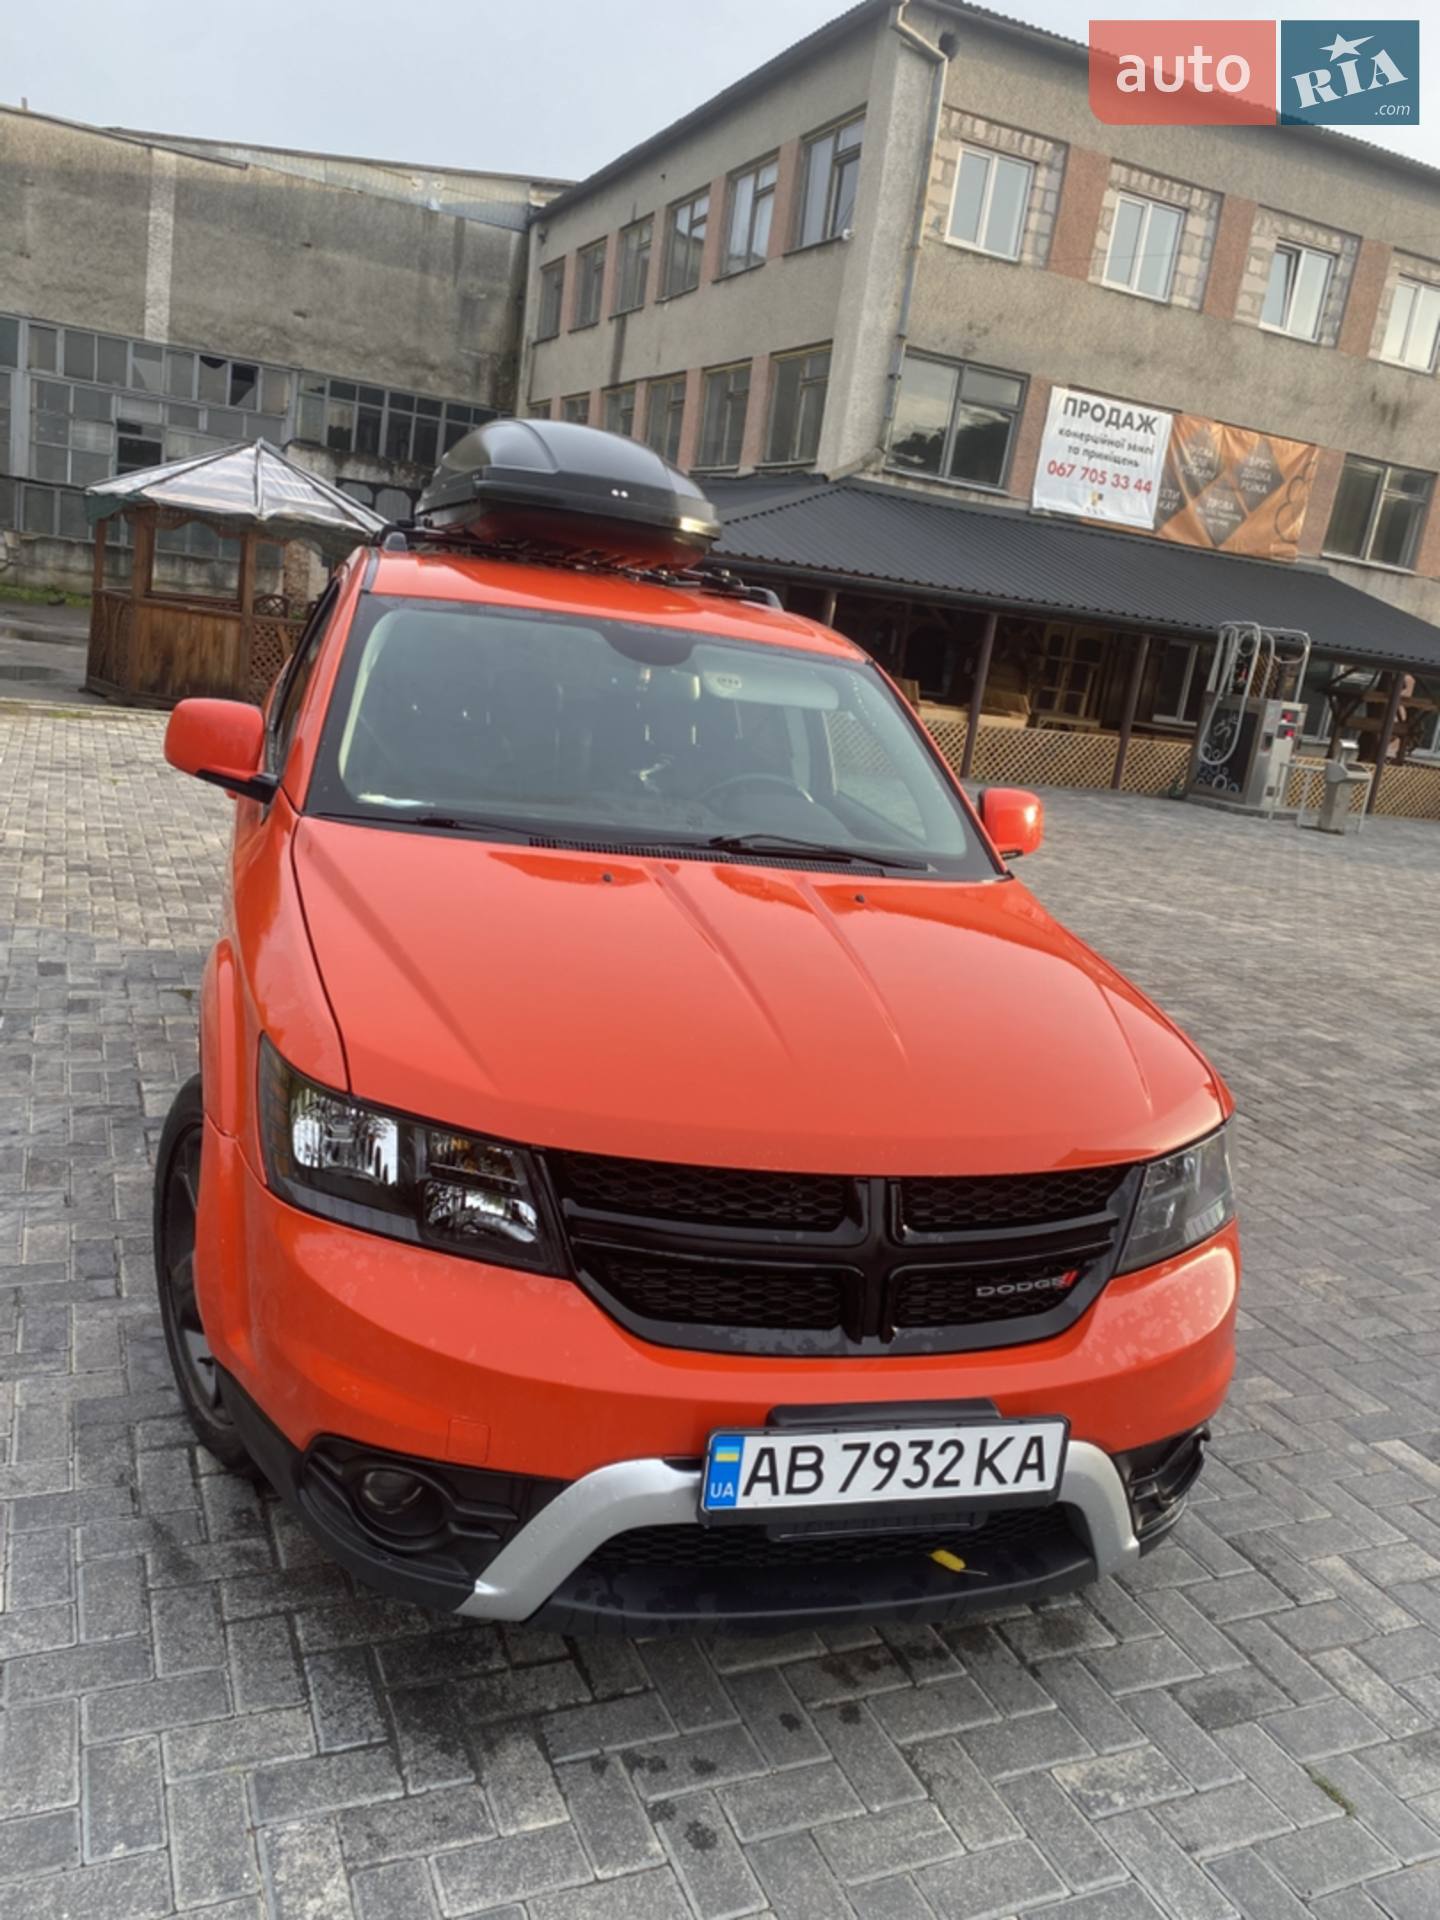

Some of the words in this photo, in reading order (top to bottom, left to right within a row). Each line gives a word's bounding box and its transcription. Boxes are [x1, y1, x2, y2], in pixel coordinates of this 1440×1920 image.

[1063, 396, 1158, 436] ПРОДАЖ
[1047, 459, 1076, 478] 067
[1080, 466, 1107, 486] 705
[1111, 472, 1130, 490] 33
[1134, 478, 1153, 495] 44
[976, 1275, 1065, 1298] DODGE
[742, 1444, 825, 1497] AB
[838, 1438, 965, 1493] 7932
[973, 1434, 1047, 1487] KA
[710, 1482, 735, 1499] UA
